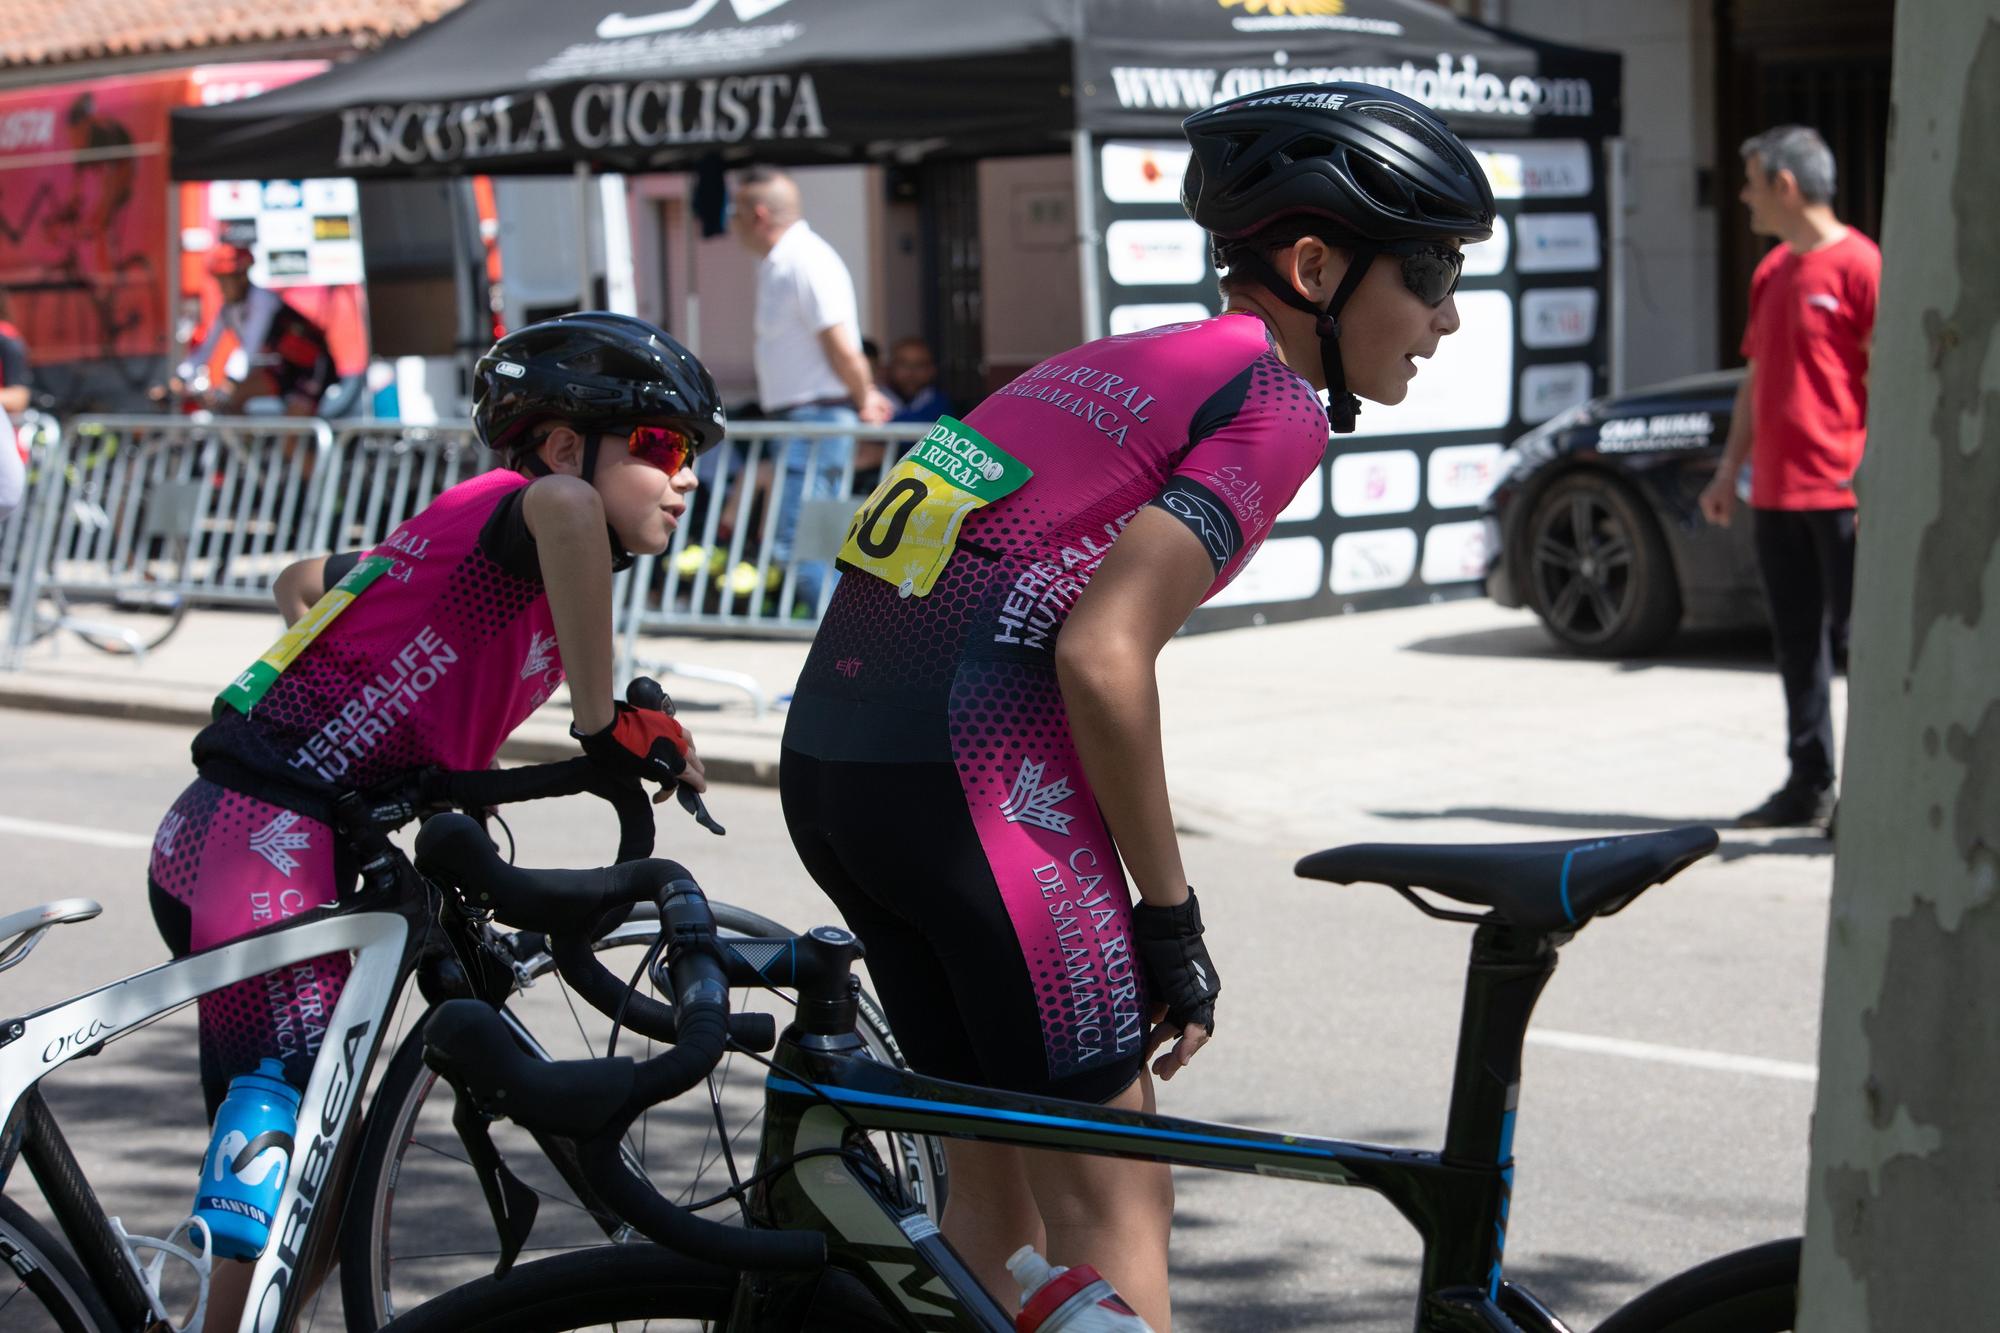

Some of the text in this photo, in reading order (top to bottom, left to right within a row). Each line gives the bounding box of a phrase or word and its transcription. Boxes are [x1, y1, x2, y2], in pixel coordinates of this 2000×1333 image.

[338, 73, 827, 168] ESCUELA CICLISTA
[1306, 101, 1344, 111] ESTEVE
[1011, 381, 1130, 448] SALAMANCA
[1060, 366, 1157, 424] RURAL
[922, 445, 981, 489] RURAL
[287, 625, 444, 769] HERBALIFE
[251, 891, 272, 922] DE
[1033, 861, 1103, 1064] DE SALAMANCA
[1068, 847, 1141, 1054] CAJA RURAL
[42, 1018, 117, 1063] Orca
[292, 965, 326, 1056] RURAL
[255, 1020, 371, 1333] ORBEA
[210, 1197, 267, 1225] CANYON
